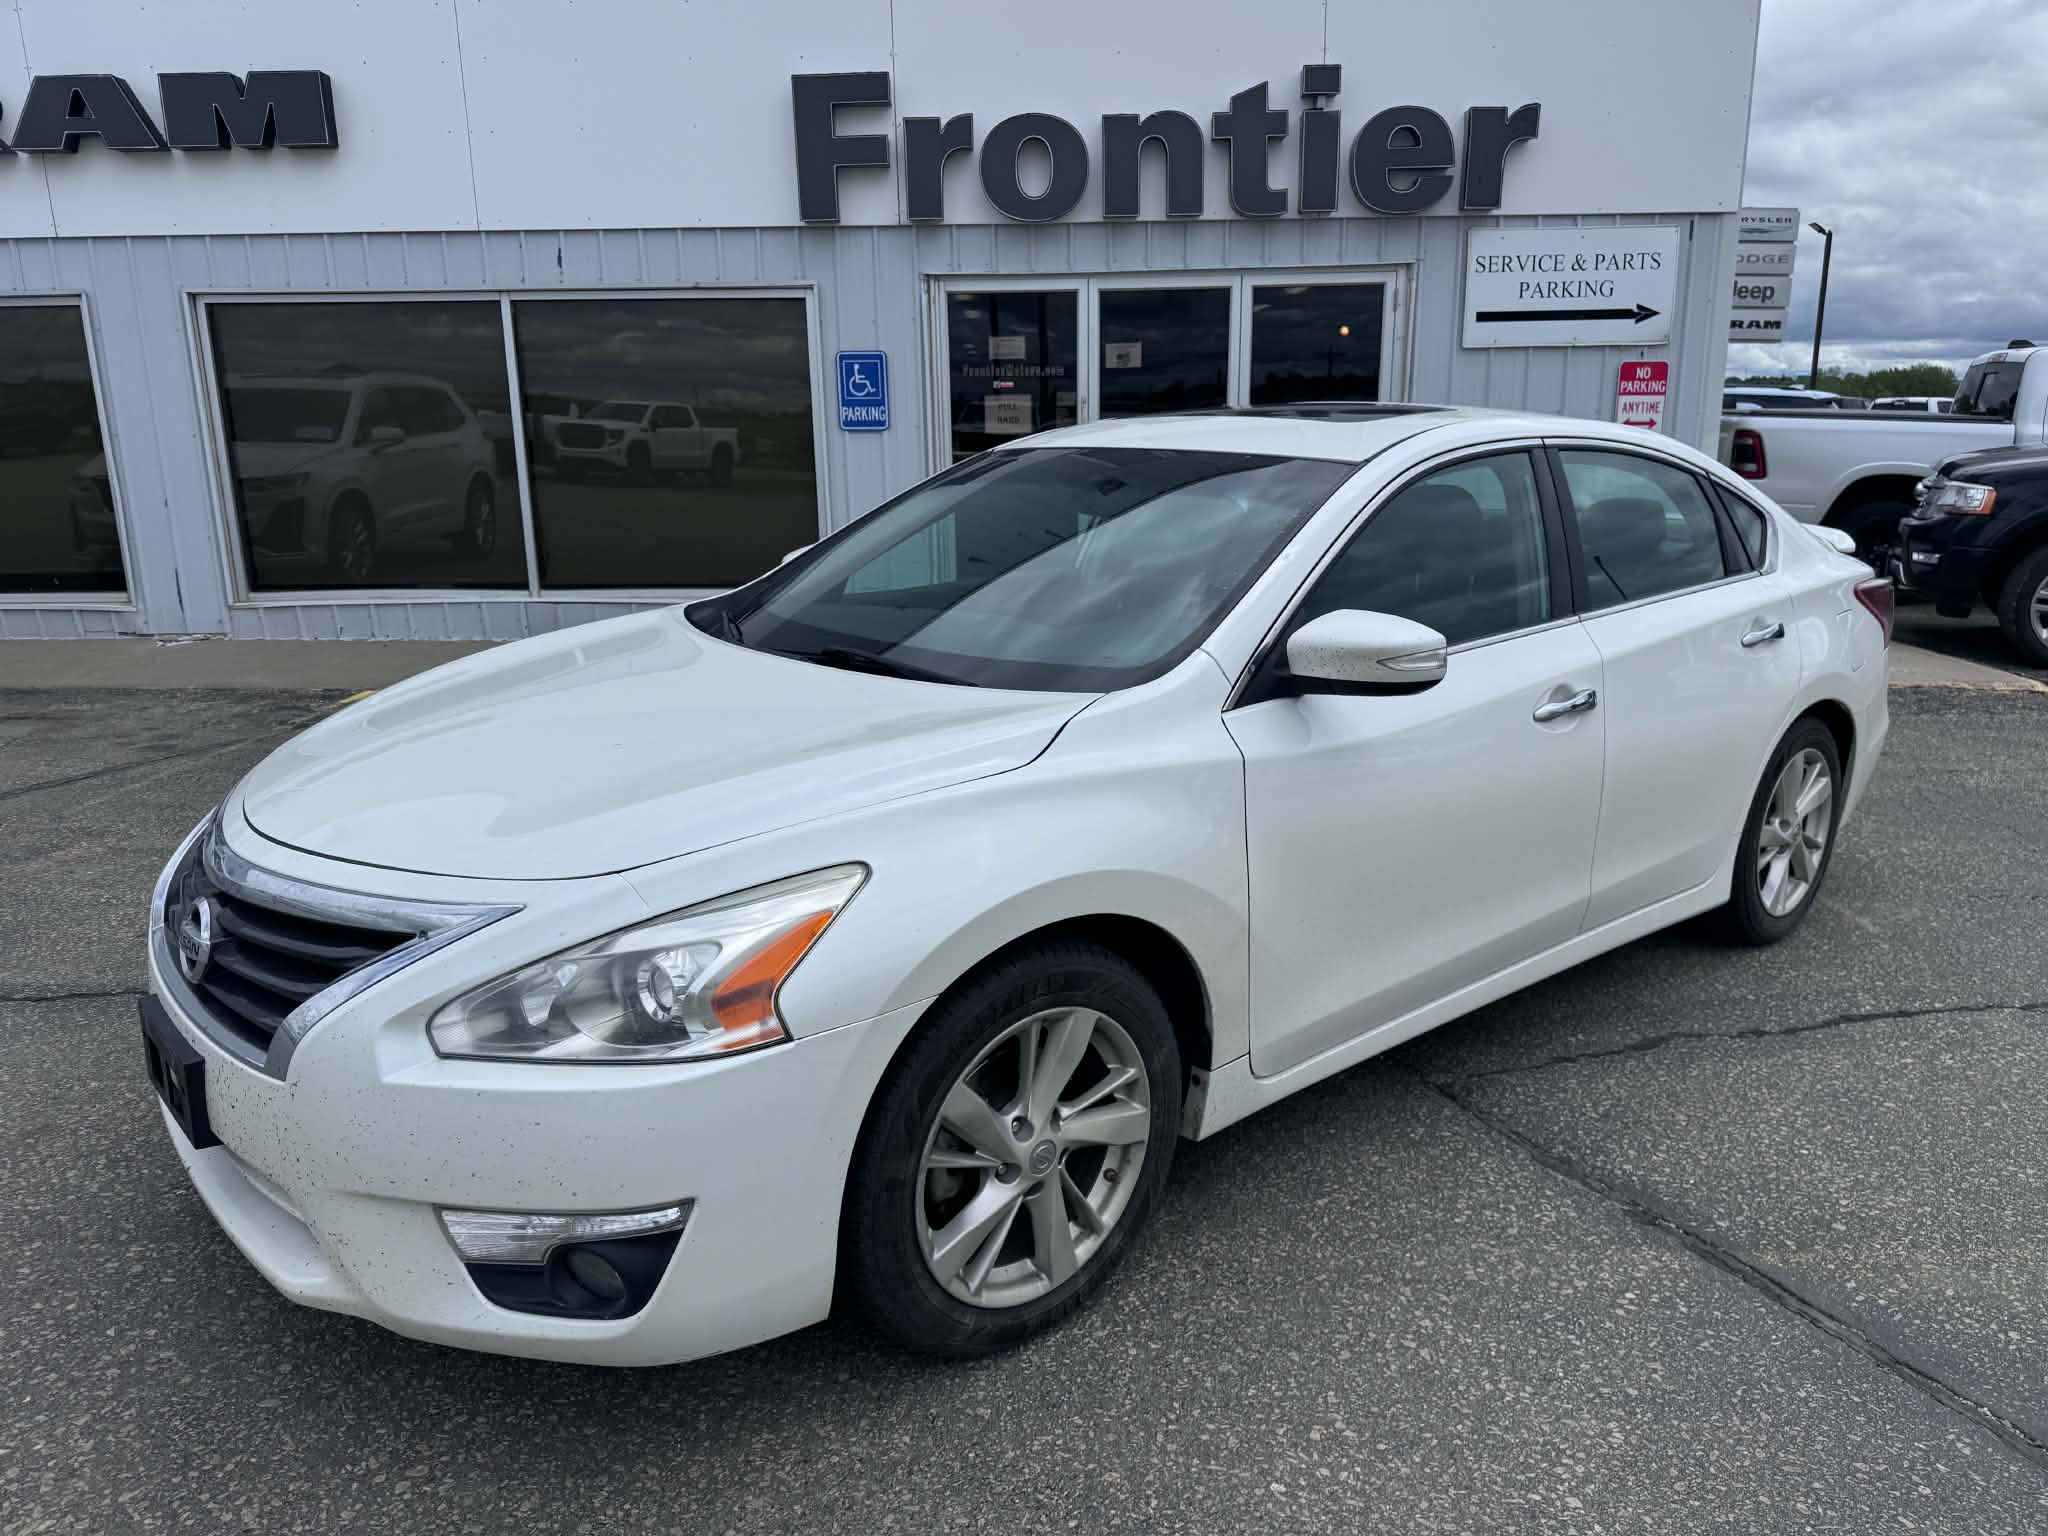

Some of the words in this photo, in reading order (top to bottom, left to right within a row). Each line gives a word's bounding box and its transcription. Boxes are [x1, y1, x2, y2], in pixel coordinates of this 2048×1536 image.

[0, 71, 338, 153] AM
[791, 64, 1541, 223] Frontier
[1741, 216, 1792, 224] RYSLER
[1475, 254, 1566, 274] SERVICE
[1571, 252, 1588, 273] &
[1594, 251, 1662, 272] PARTS
[1736, 254, 1790, 265] ODGE
[1519, 279, 1615, 300] PARKING
[1728, 319, 1782, 330] RAM
[1635, 367, 1652, 380] NO
[1620, 380, 1667, 393] PARKING
[842, 406, 886, 421] PARKING
[1621, 401, 1661, 415] ANYTIME
